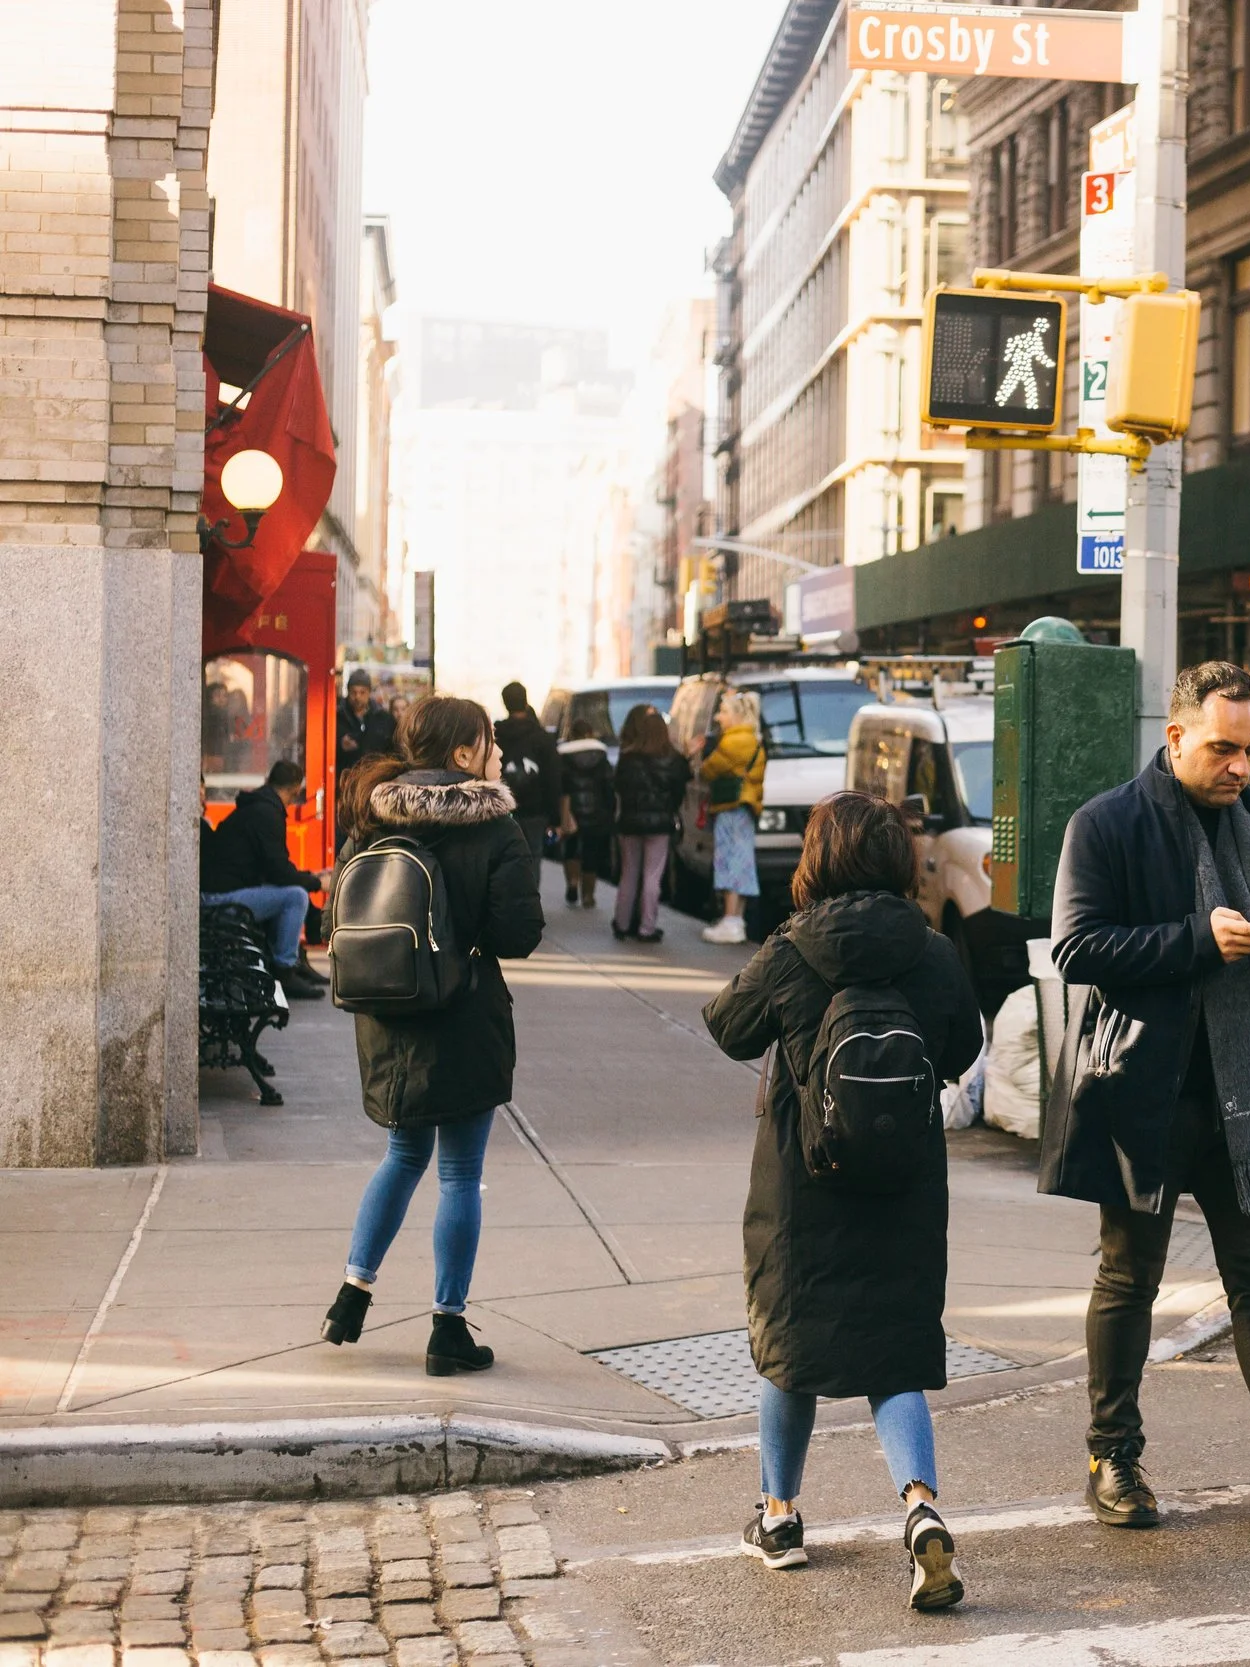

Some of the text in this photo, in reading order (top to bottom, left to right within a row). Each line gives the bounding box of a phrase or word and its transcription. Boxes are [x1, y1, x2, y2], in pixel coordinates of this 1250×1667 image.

[859, 16, 1049, 75] Crosby St
[1091, 177, 1109, 213] 3
[1088, 362, 1107, 399] 2
[1093, 546, 1124, 568] 1013
